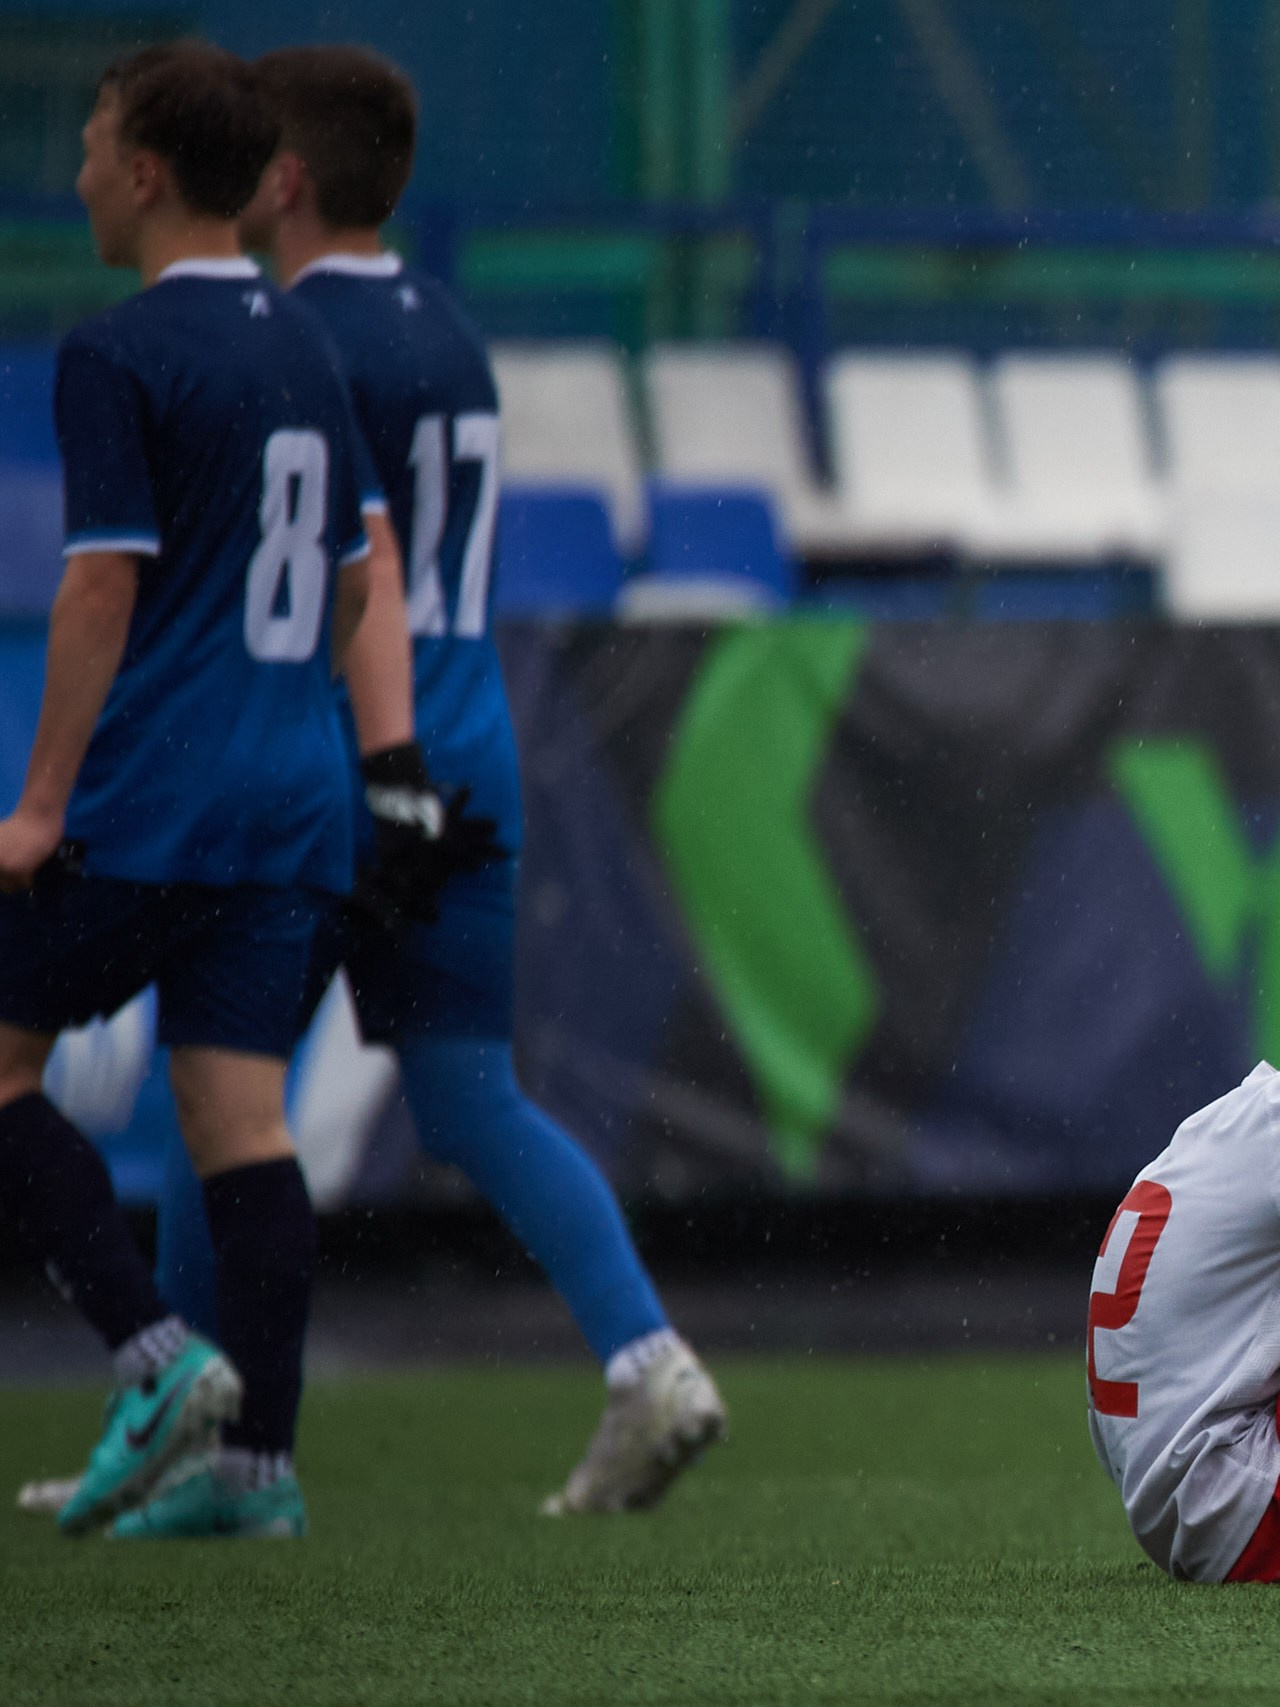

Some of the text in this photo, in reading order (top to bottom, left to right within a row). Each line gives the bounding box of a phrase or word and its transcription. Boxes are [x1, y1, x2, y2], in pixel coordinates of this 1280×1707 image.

[243, 428, 329, 662] 8
[407, 411, 499, 639] 17
[1087, 1179, 1173, 1419] 2
